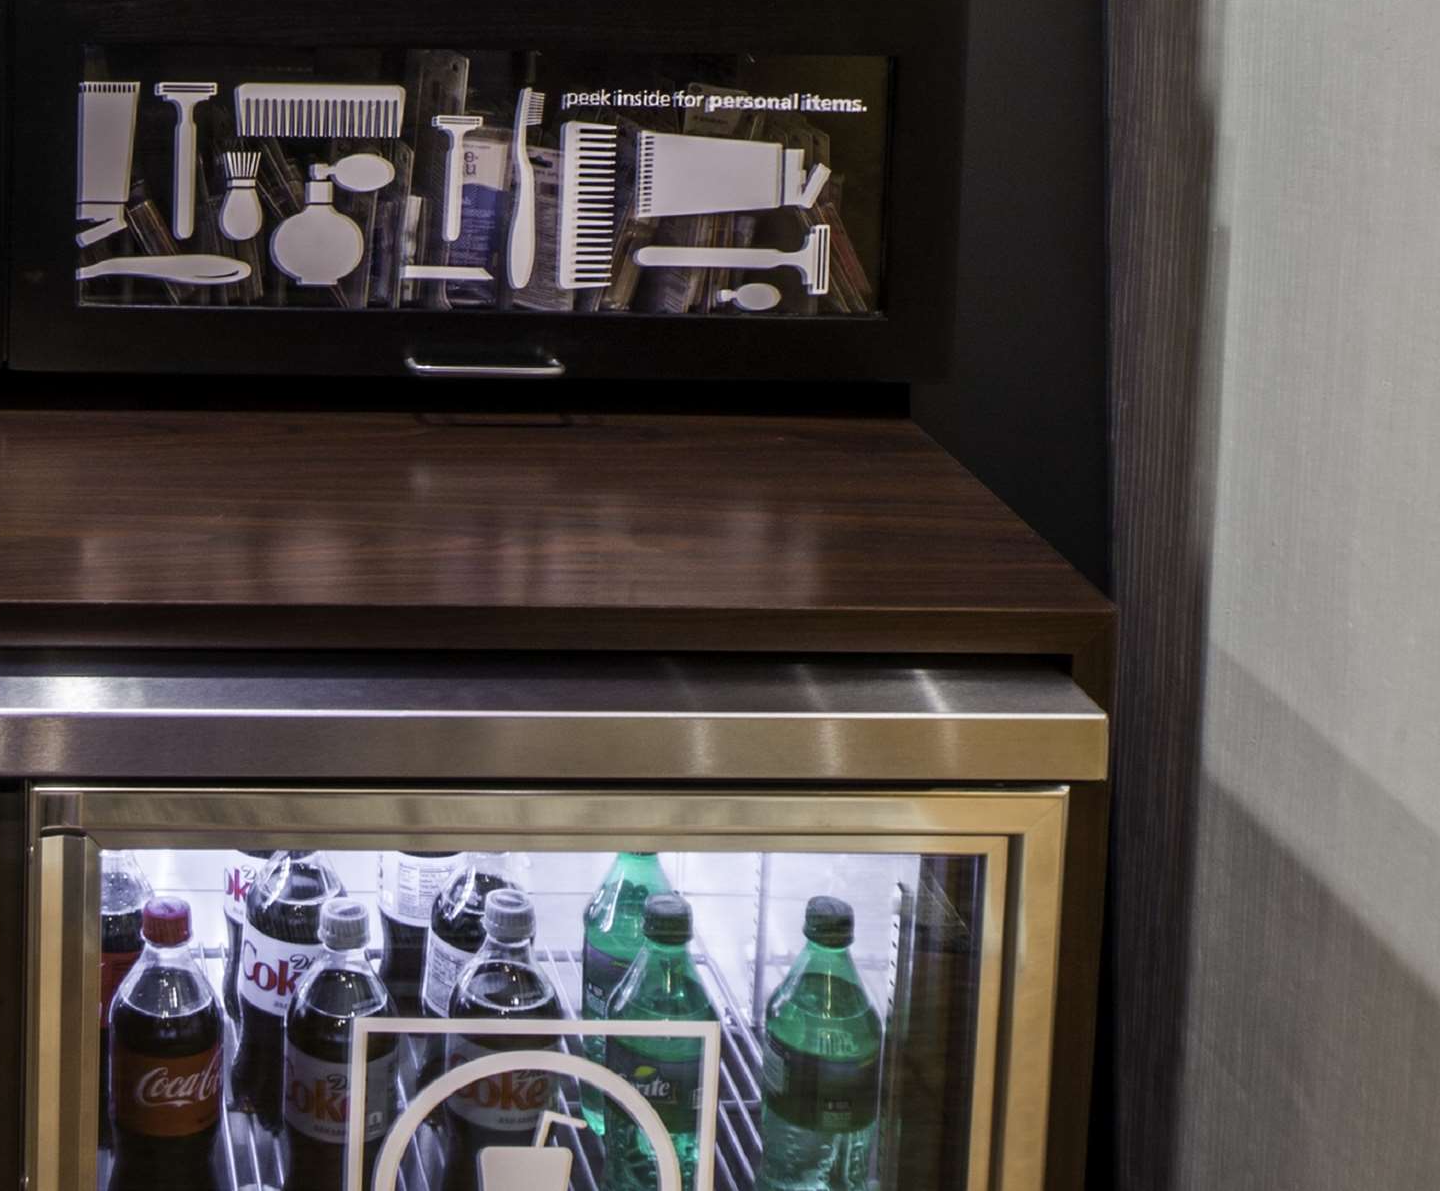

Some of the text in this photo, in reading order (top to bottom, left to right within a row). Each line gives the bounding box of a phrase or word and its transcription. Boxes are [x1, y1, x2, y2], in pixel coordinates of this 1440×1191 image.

[563, 89, 868, 112] peek inside for personal items.
[243, 940, 299, 996] Cok
